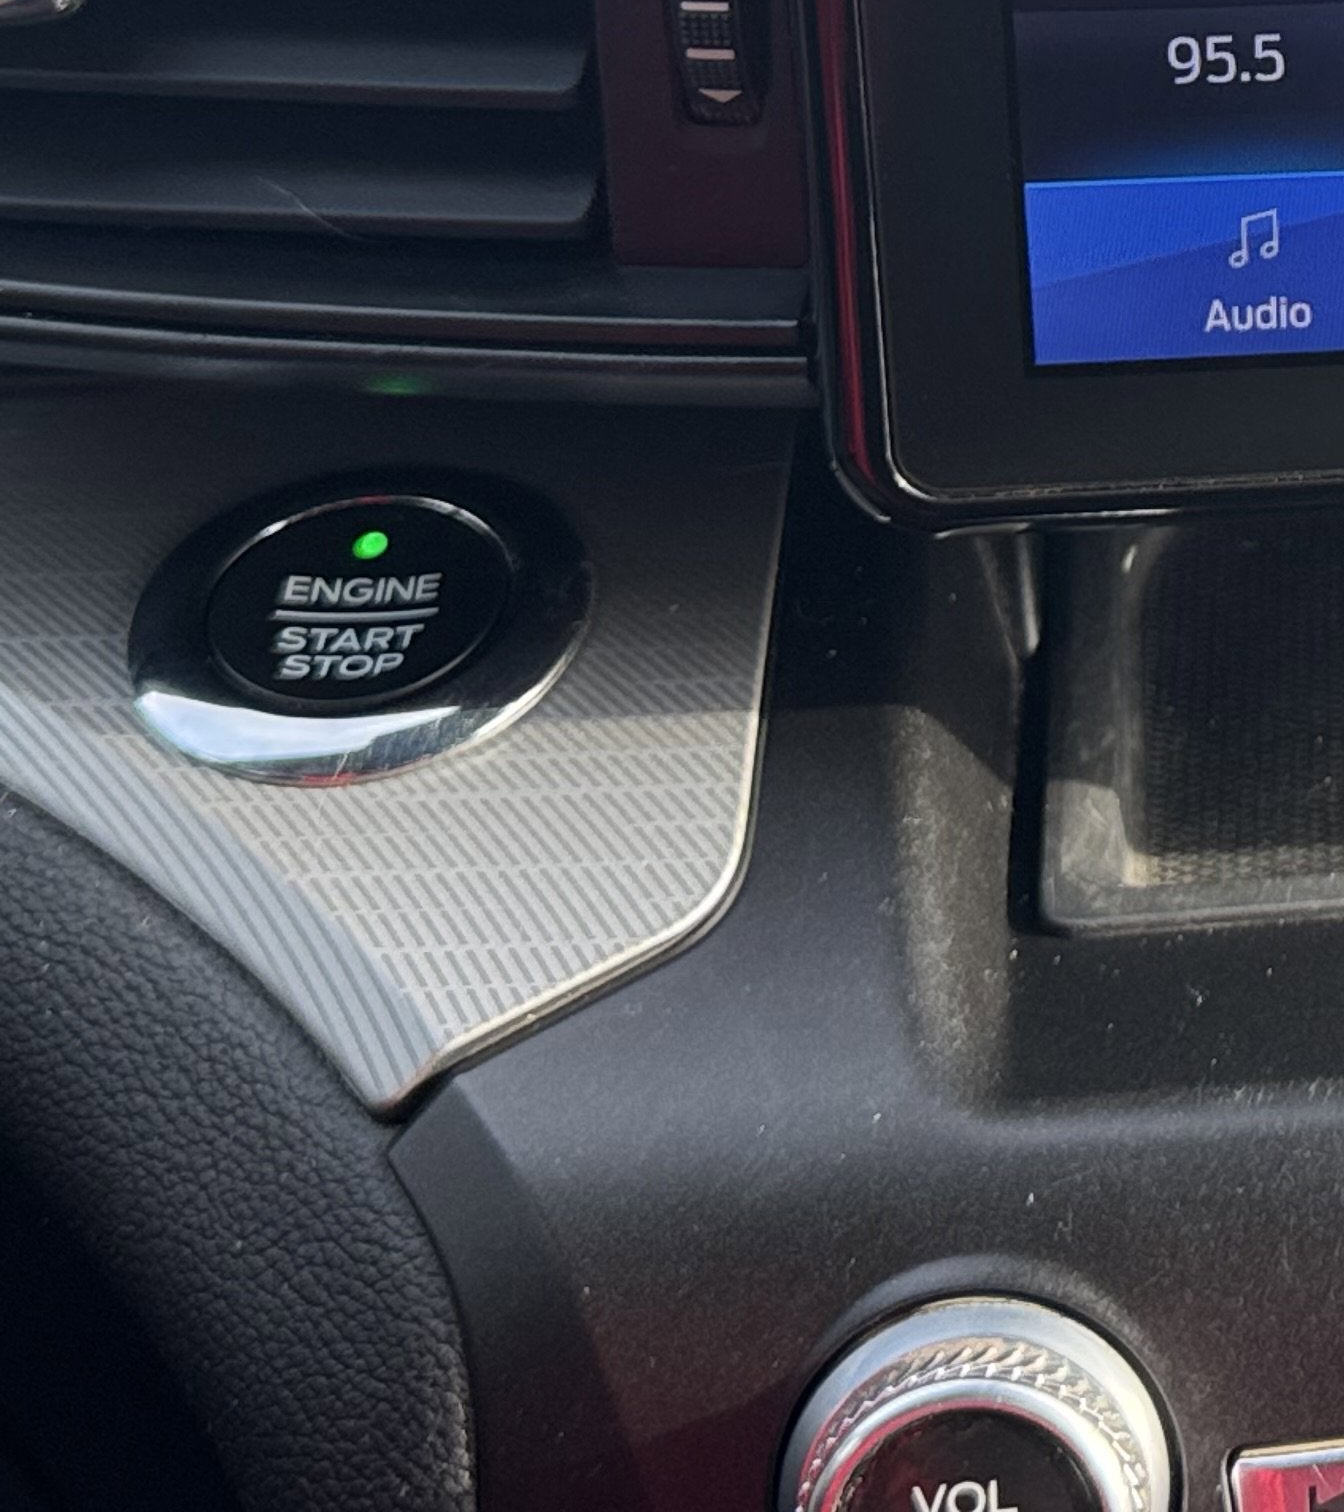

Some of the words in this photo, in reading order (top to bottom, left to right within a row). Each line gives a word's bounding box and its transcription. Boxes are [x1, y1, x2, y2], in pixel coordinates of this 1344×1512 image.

[1167, 33, 1285, 85] 95.5
[1204, 296, 1312, 332] Audio
[282, 573, 441, 606] ENGINE
[277, 624, 424, 655] START
[280, 652, 404, 679] STOP
[912, 1479, 1019, 1512] VOL
